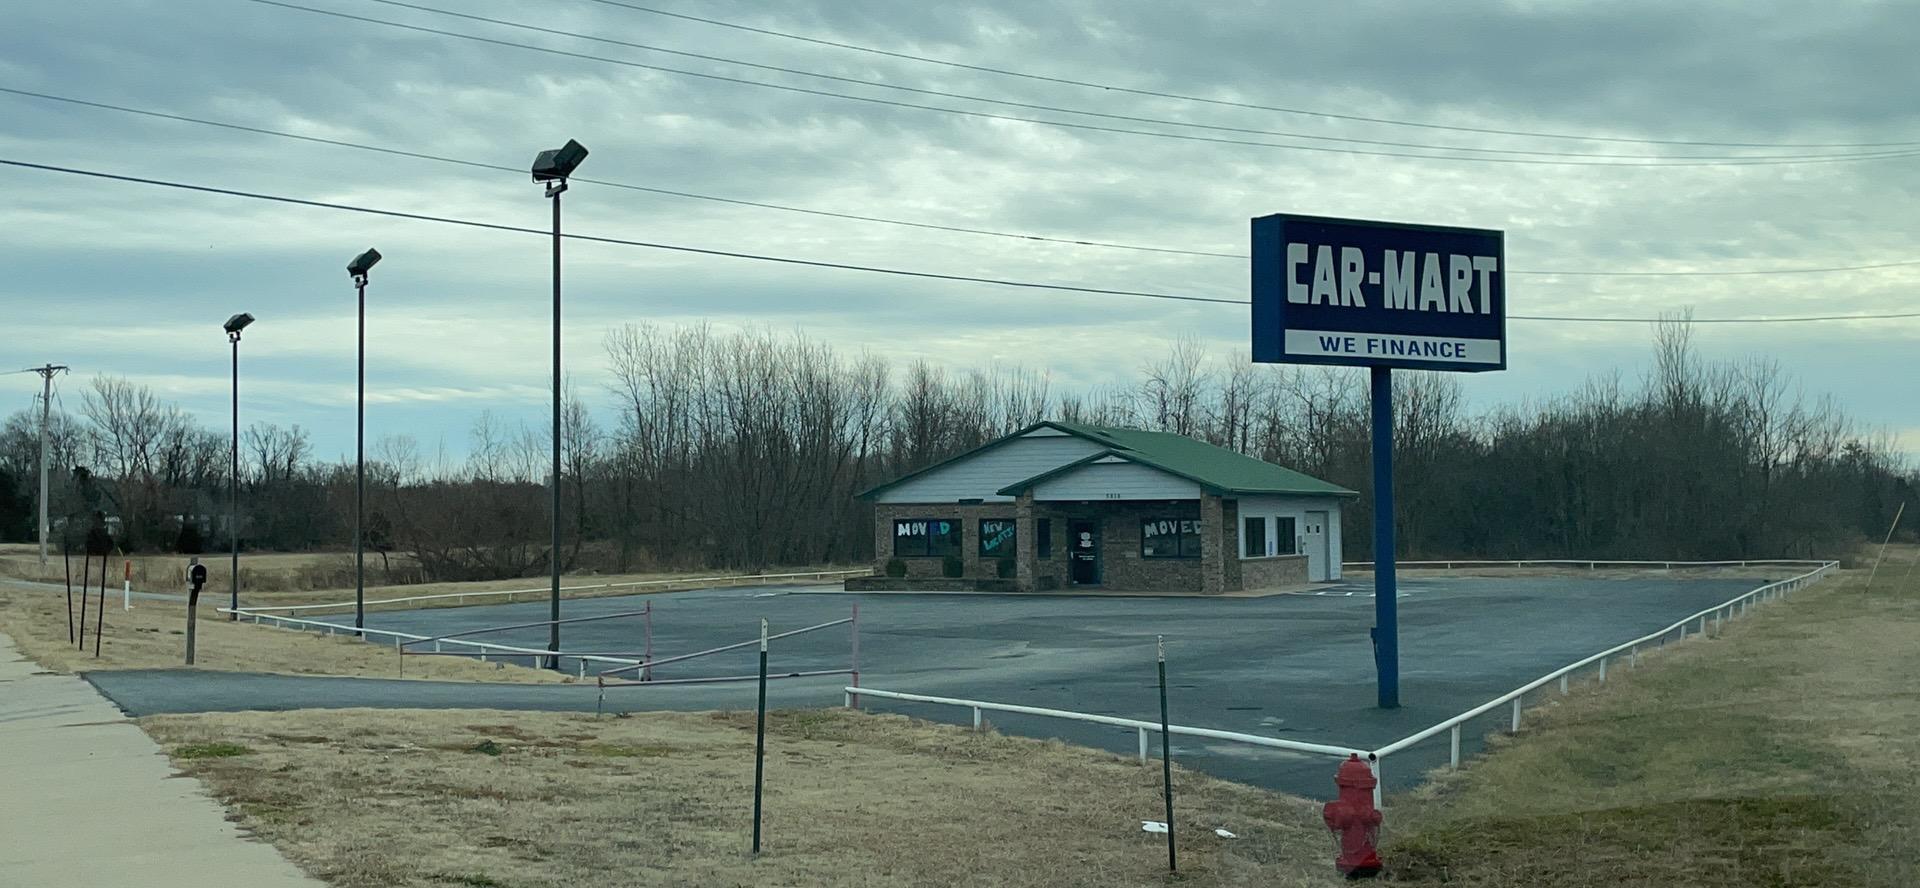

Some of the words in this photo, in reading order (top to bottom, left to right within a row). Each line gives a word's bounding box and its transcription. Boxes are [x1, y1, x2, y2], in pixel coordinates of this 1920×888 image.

[1287, 243, 1497, 314] CAR-MART
[1319, 336, 1356, 353] WE
[1367, 338, 1466, 358] FINANCE
[1144, 520, 1201, 538] MOVED
